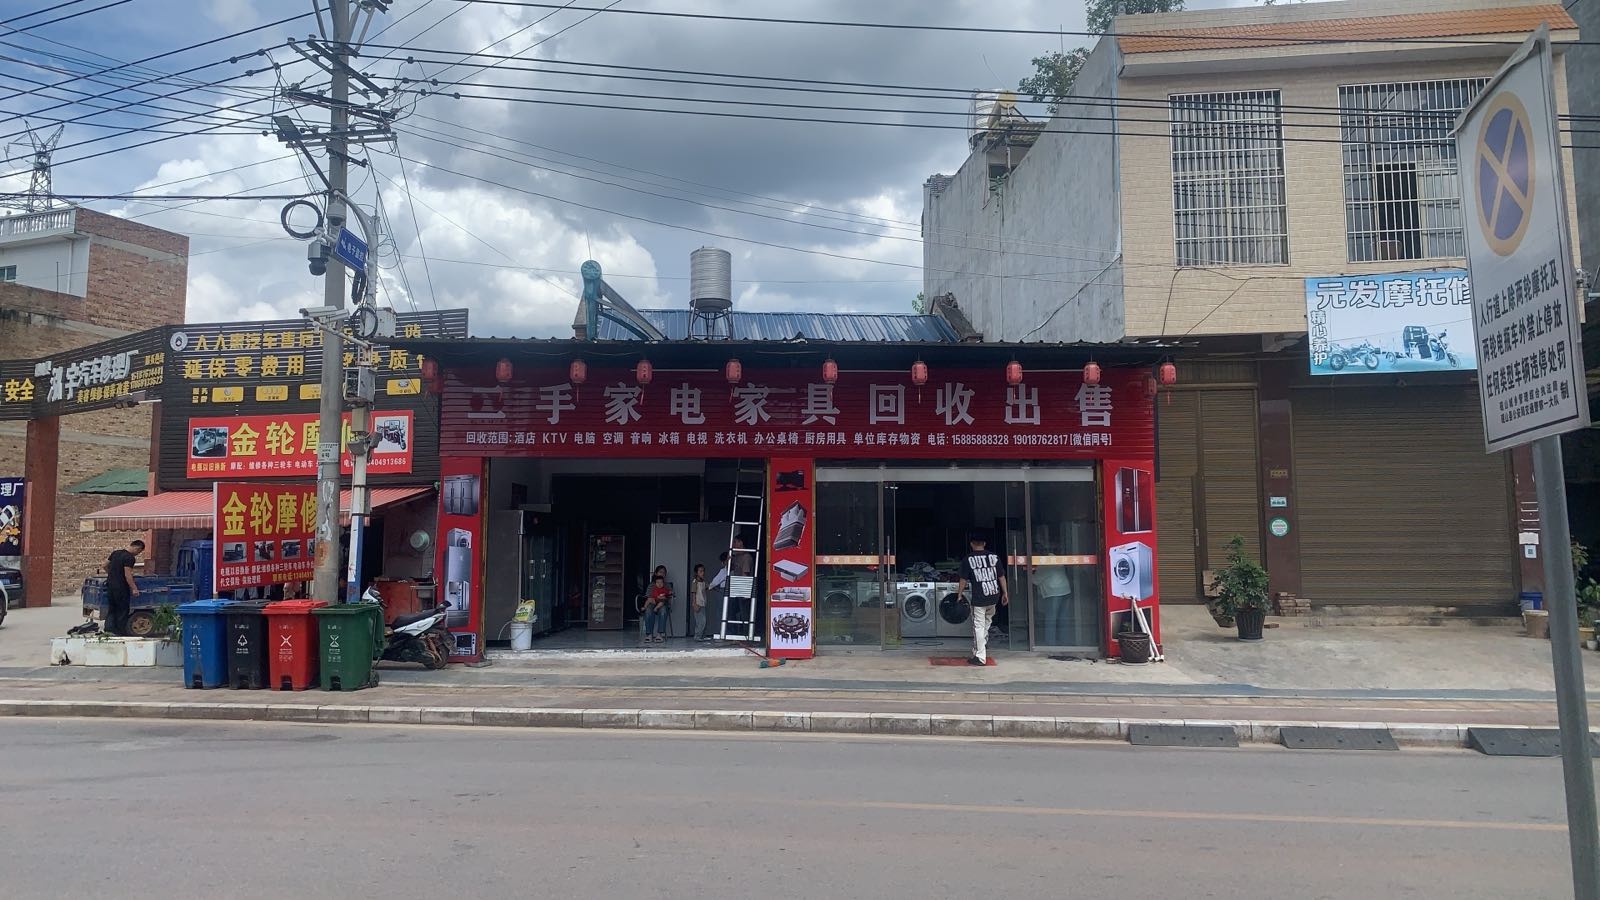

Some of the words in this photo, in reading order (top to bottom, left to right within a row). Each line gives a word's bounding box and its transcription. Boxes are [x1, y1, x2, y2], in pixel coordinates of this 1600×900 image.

[1316, 276, 1471, 309] 元发摩托修
[1480, 259, 1559, 327] 人行道上除两轮摩托及
[1310, 310, 1328, 366] 精心养护
[1482, 299, 1563, 363] 两轮电瓶车外禁止停放
[184, 354, 304, 379] 延保零费用
[1486, 341, 1566, 398] 任何类型车辆违停处罚
[5, 378, 35, 402] 安全
[467, 382, 1113, 427] 二手家电家具回收出售
[542, 433, 568, 444] KTV
[574, 432, 596, 445] 电脑
[603, 432, 624, 445] 空调
[630, 432, 652, 445] 音响
[658, 432, 680, 445] 冰箱
[687, 432, 708, 445] 电视
[714, 432, 748, 445] 洗衣机
[754, 432, 799, 445] 办公桌椅
[805, 432, 846, 445] 厨房用具
[853, 432, 921, 445] 单位库存物资
[222, 490, 317, 536] 金轮摩修
[968, 555, 988, 570] OUT
[988, 554, 999, 567] OF
